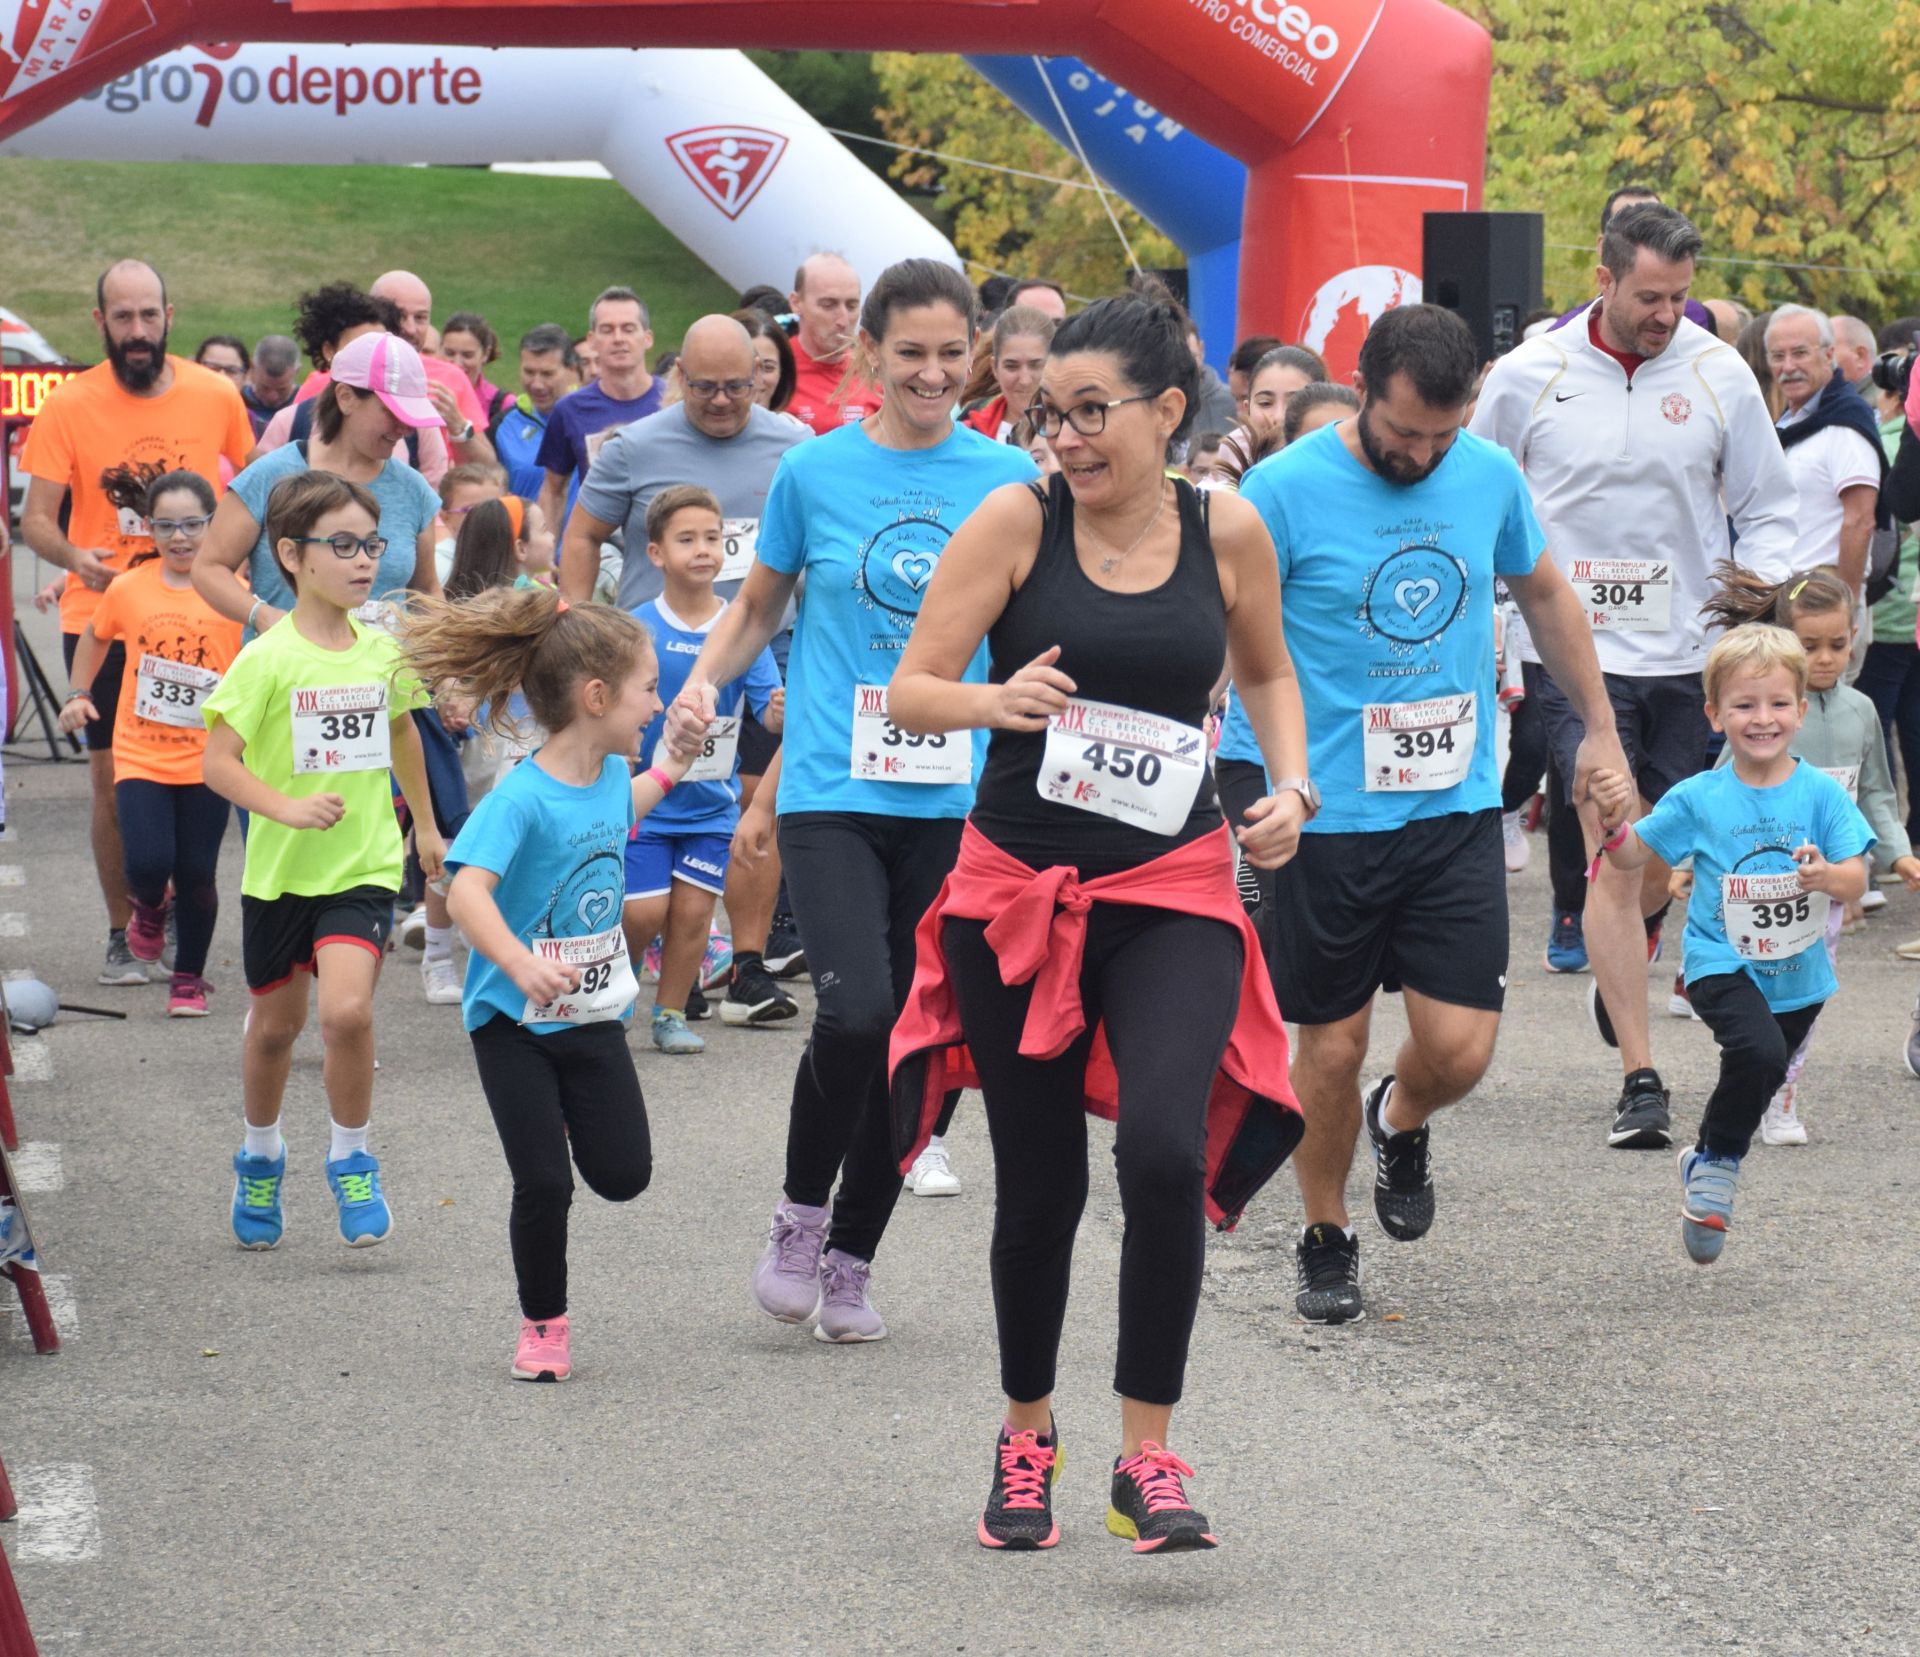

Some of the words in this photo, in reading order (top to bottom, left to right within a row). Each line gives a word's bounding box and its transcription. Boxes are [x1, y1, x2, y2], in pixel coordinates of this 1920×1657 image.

[1235, 0, 1339, 60] ceo
[1229, 15, 1319, 87] COMERCIAL
[268, 55, 482, 116] deporte
[1574, 560, 1591, 578] XIX
[1591, 584, 1644, 605] 304
[150, 681, 196, 706] 333
[297, 691, 318, 711] XIX
[862, 689, 882, 711] XIX
[321, 712, 375, 740] 387
[1057, 704, 1087, 731] XIX
[1089, 707, 1130, 721] CARRERA
[1132, 715, 1171, 732] POPULAR
[1370, 707, 1391, 728] XIX
[1088, 727, 1113, 738] TRES
[1118, 732, 1166, 749] PARQUES
[1116, 722, 1160, 738] BERCEO
[1394, 727, 1455, 758] 394
[1082, 742, 1162, 786] 450
[1729, 878, 1749, 898] XIX
[1751, 877, 1780, 885] CARRERA
[1752, 896, 1810, 929] 395
[565, 938, 595, 948] CARRERA
